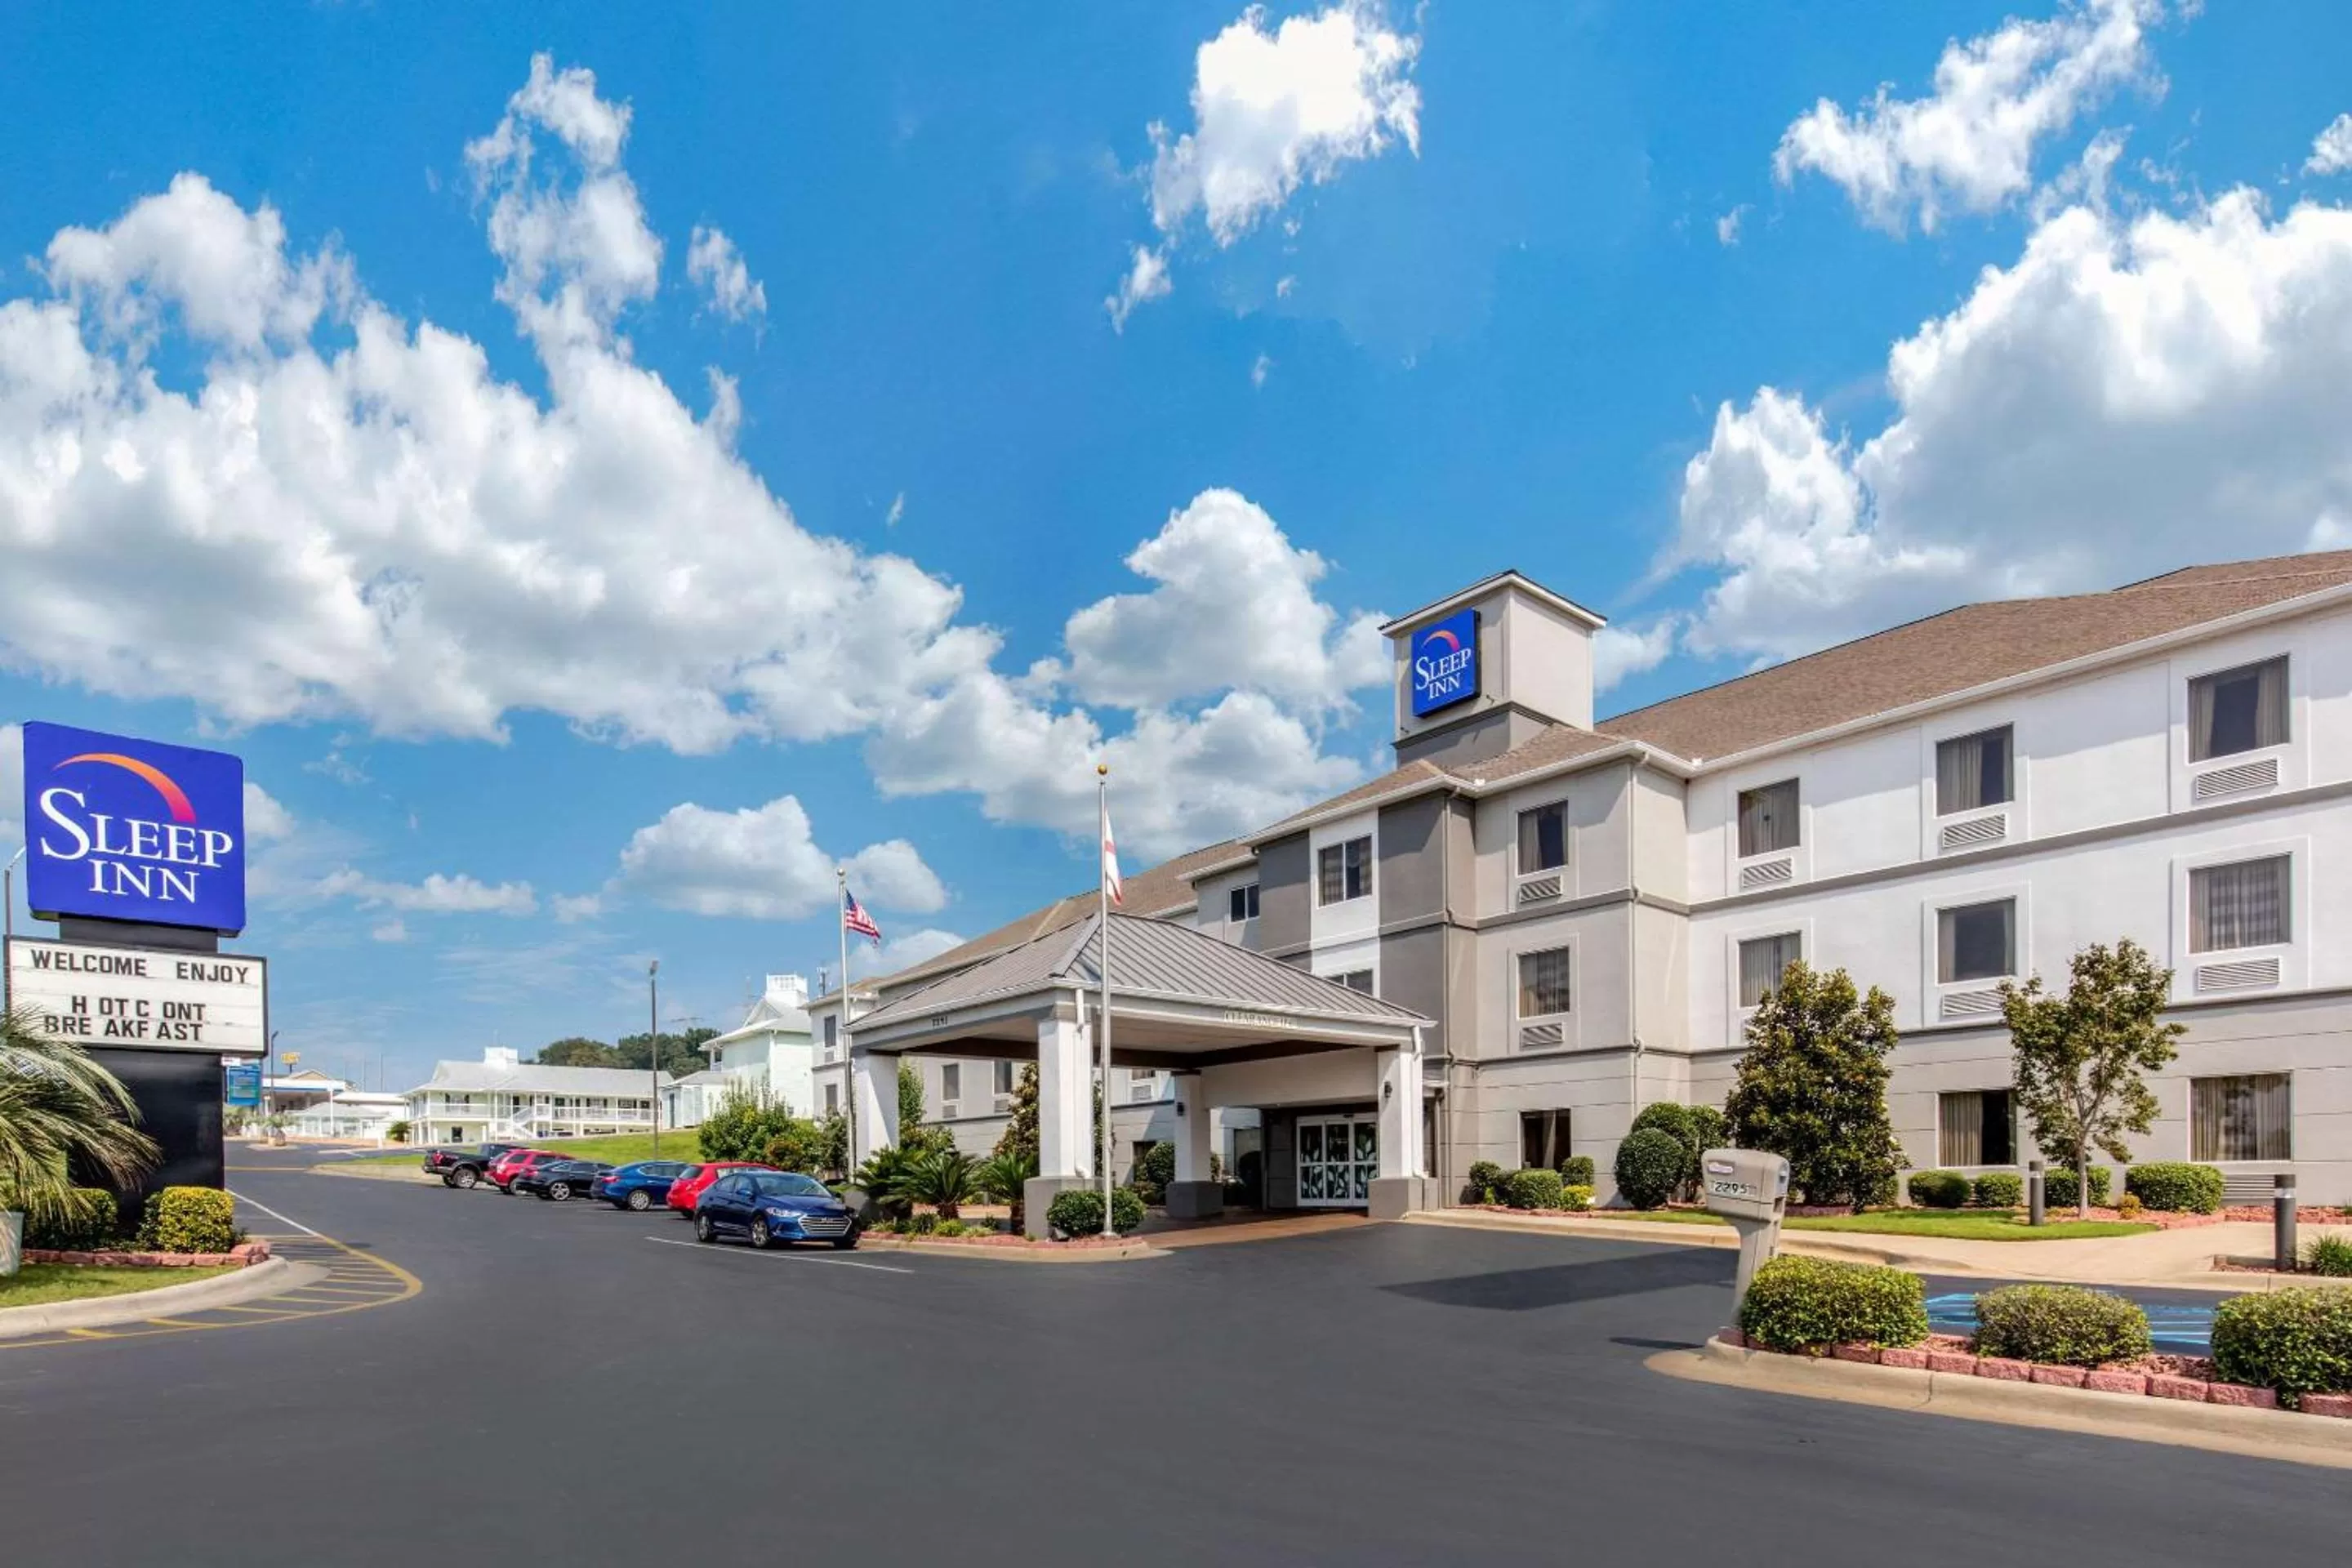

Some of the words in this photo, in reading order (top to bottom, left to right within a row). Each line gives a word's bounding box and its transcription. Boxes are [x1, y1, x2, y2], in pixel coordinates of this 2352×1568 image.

[1415, 647, 1472, 690] SLEEP
[1428, 672, 1462, 699] INN
[39, 787, 234, 868] SLEEP
[88, 859, 200, 903] INN
[31, 949, 147, 977] WELCOME
[176, 962, 249, 985] ENJOY
